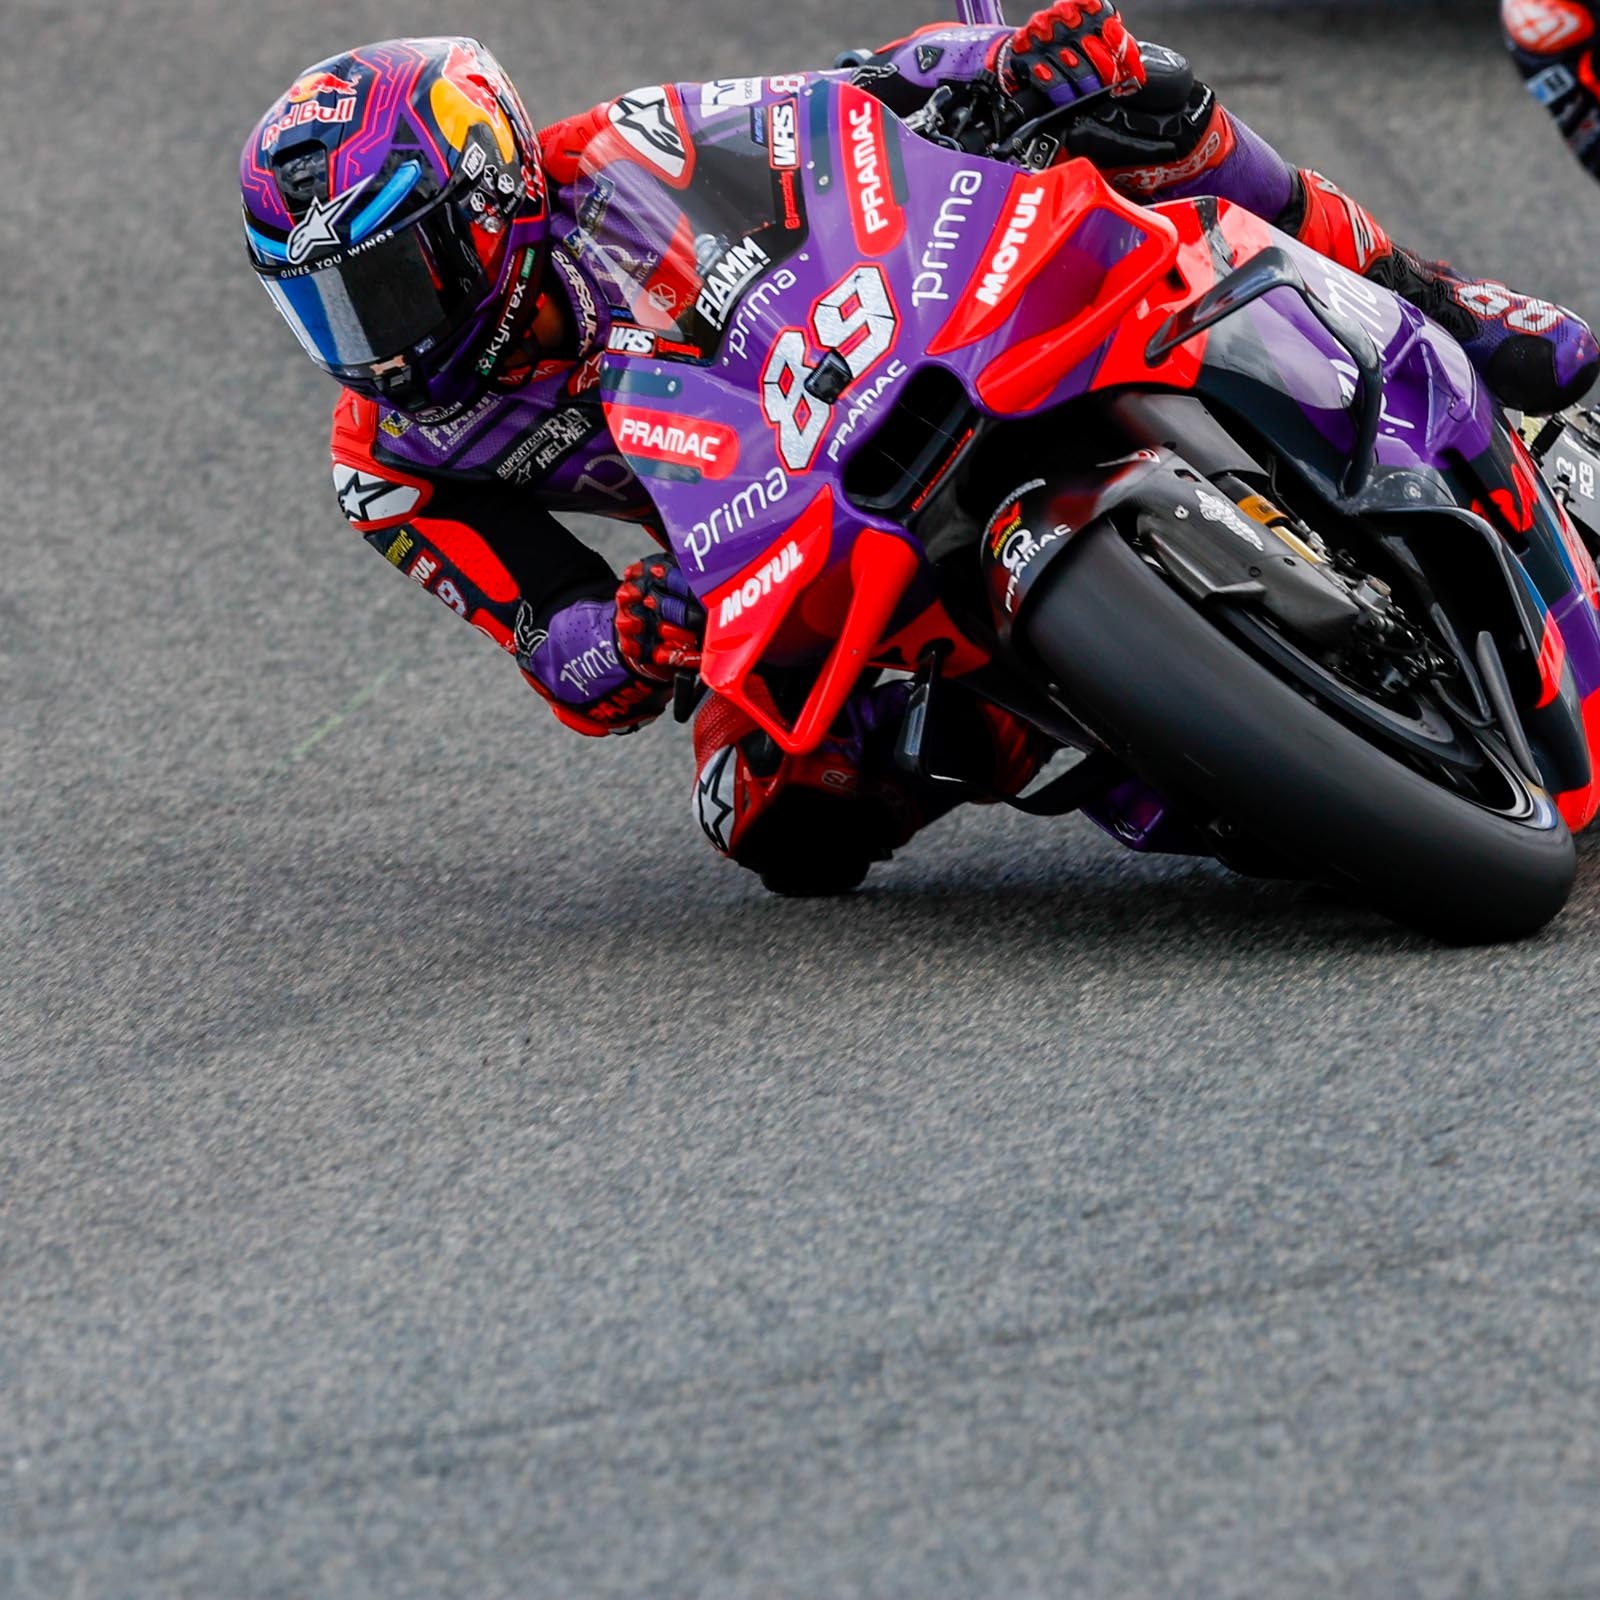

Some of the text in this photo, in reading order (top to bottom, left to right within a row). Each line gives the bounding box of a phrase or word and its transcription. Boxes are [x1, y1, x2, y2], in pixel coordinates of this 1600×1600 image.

[261, 97, 357, 150] Rd Bull
[771, 104, 797, 166] WRS
[851, 102, 889, 234] PRAMAC
[280, 228, 395, 279] GIVES YOU WINGS
[912, 170, 982, 307] prima
[975, 186, 1045, 307] MOTUL
[695, 236, 771, 330] FIAMM
[729, 267, 797, 360] prima
[485, 281, 527, 357] kyrrex
[607, 326, 655, 354] WRS
[760, 263, 900, 474] 89
[535, 416, 592, 470] HELMET
[619, 418, 720, 462] PRAMAC
[827, 358, 908, 463] PRAMAC
[497, 425, 550, 478] SUPERTECH
[1580, 461, 1596, 500] RCB
[684, 467, 789, 572] prima
[409, 555, 437, 586] TUL
[433, 577, 468, 617] 9
[719, 541, 804, 627] MOTUL
